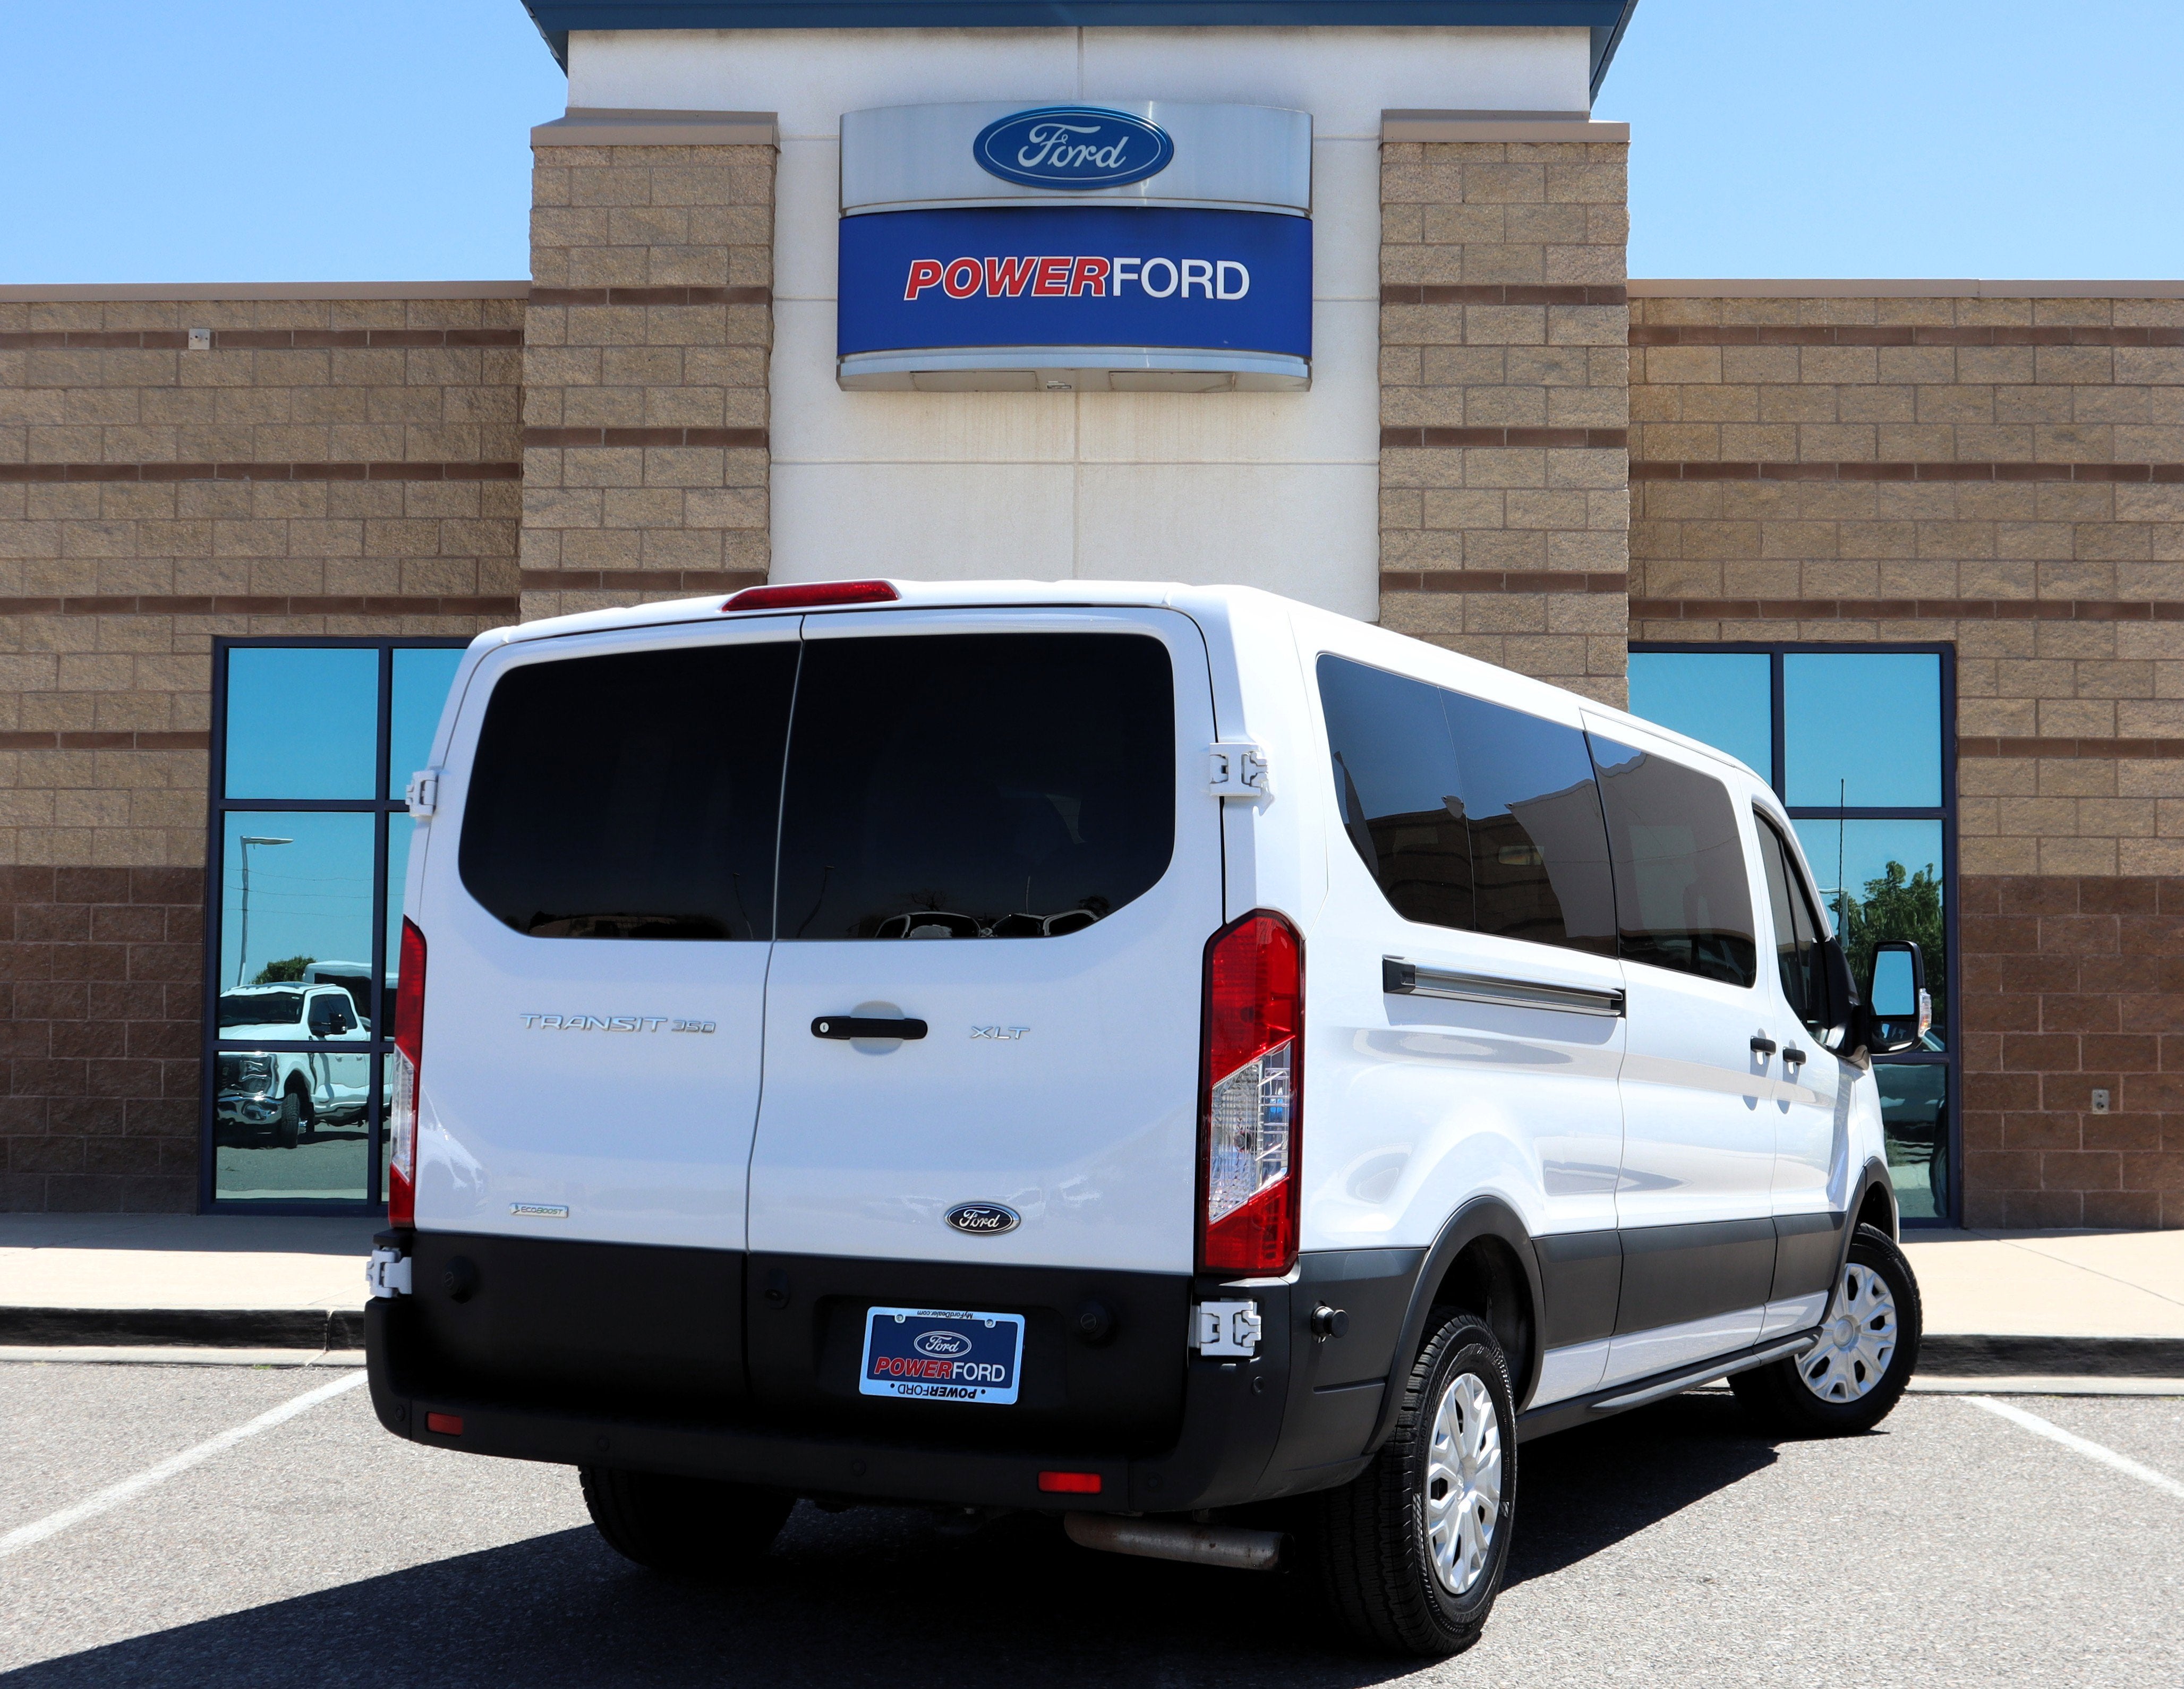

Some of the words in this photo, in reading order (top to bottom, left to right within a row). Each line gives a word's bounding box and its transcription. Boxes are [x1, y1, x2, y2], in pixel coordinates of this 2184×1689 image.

[1018, 123, 1130, 168] Ford
[903, 256, 1251, 301] POWERFORD
[519, 1013, 668, 1033] TRANSIT
[671, 1020, 716, 1034] 350
[970, 1026, 1030, 1040] XLT
[521, 1206, 564, 1215] ECOBOOST
[959, 1209, 1001, 1227] Ford
[917, 1310, 974, 1320] MyFordDealer.com
[925, 1335, 960, 1353] Ford
[874, 1356, 1006, 1382] POWERFORD
[897, 1383, 978, 1399] POWERFORD
